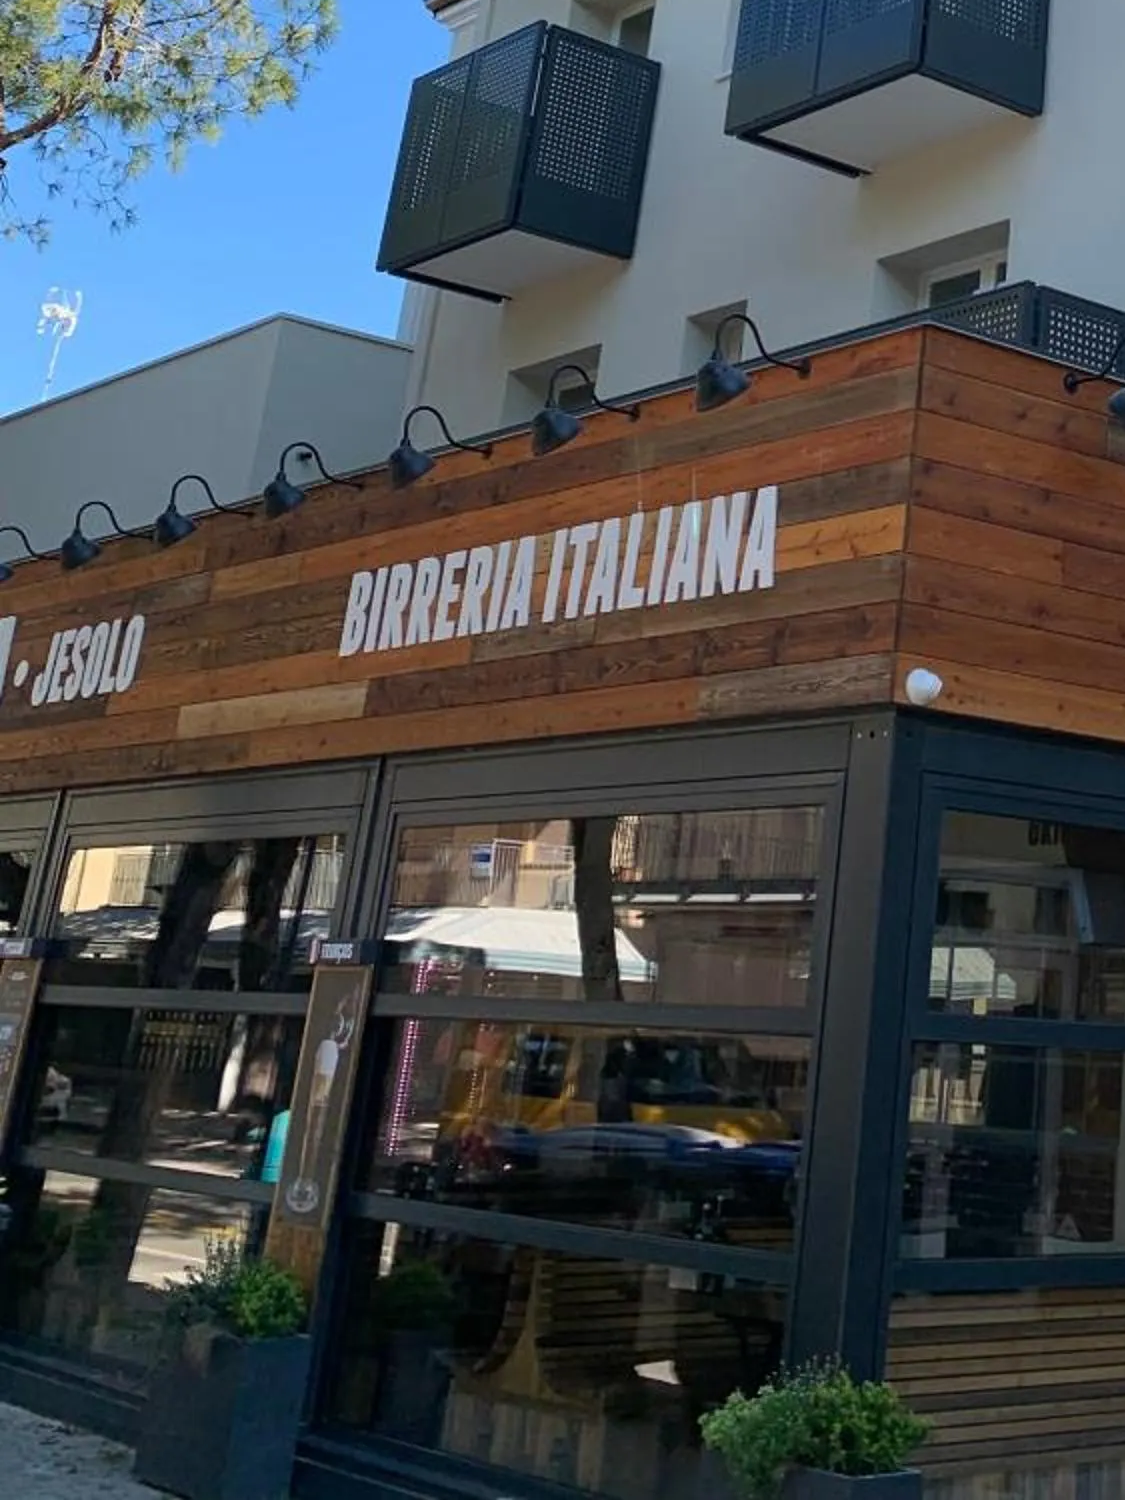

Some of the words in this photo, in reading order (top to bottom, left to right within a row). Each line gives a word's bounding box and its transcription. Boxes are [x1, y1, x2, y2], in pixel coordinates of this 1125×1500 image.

[339, 535, 537, 657] BIRRERIA
[541, 485, 779, 624] ITALIANA
[31, 614, 145, 707] JESOLO
